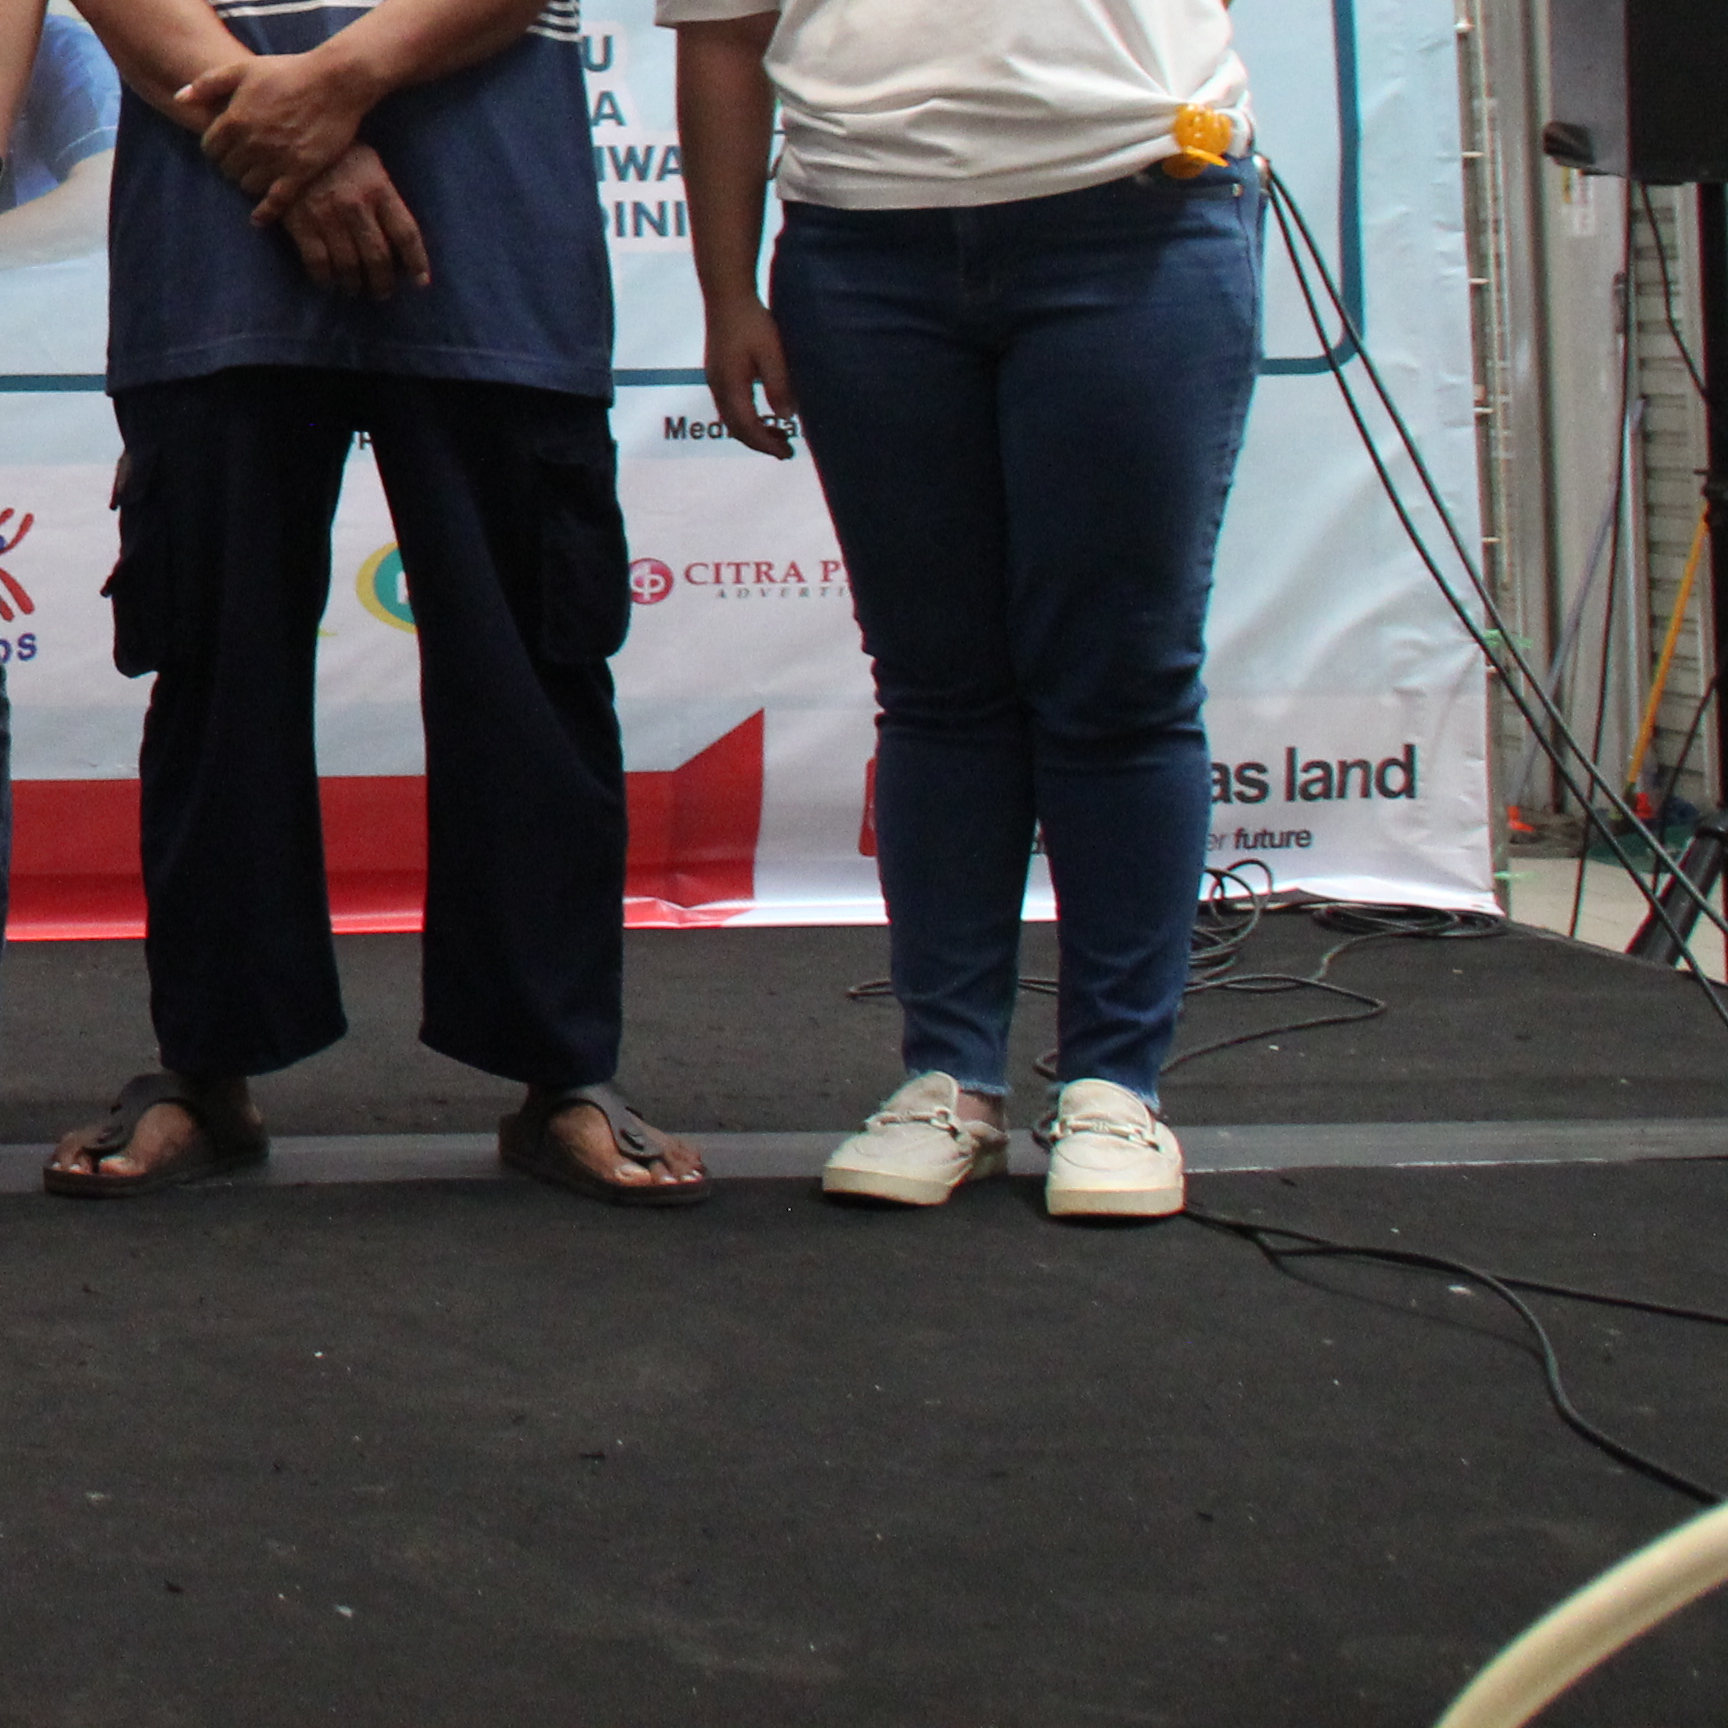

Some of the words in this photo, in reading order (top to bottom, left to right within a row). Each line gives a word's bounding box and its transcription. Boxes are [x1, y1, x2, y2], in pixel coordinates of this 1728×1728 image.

[683, 560, 807, 586] CITRA
[1284, 743, 1417, 803] land
[1233, 826, 1314, 850] future
